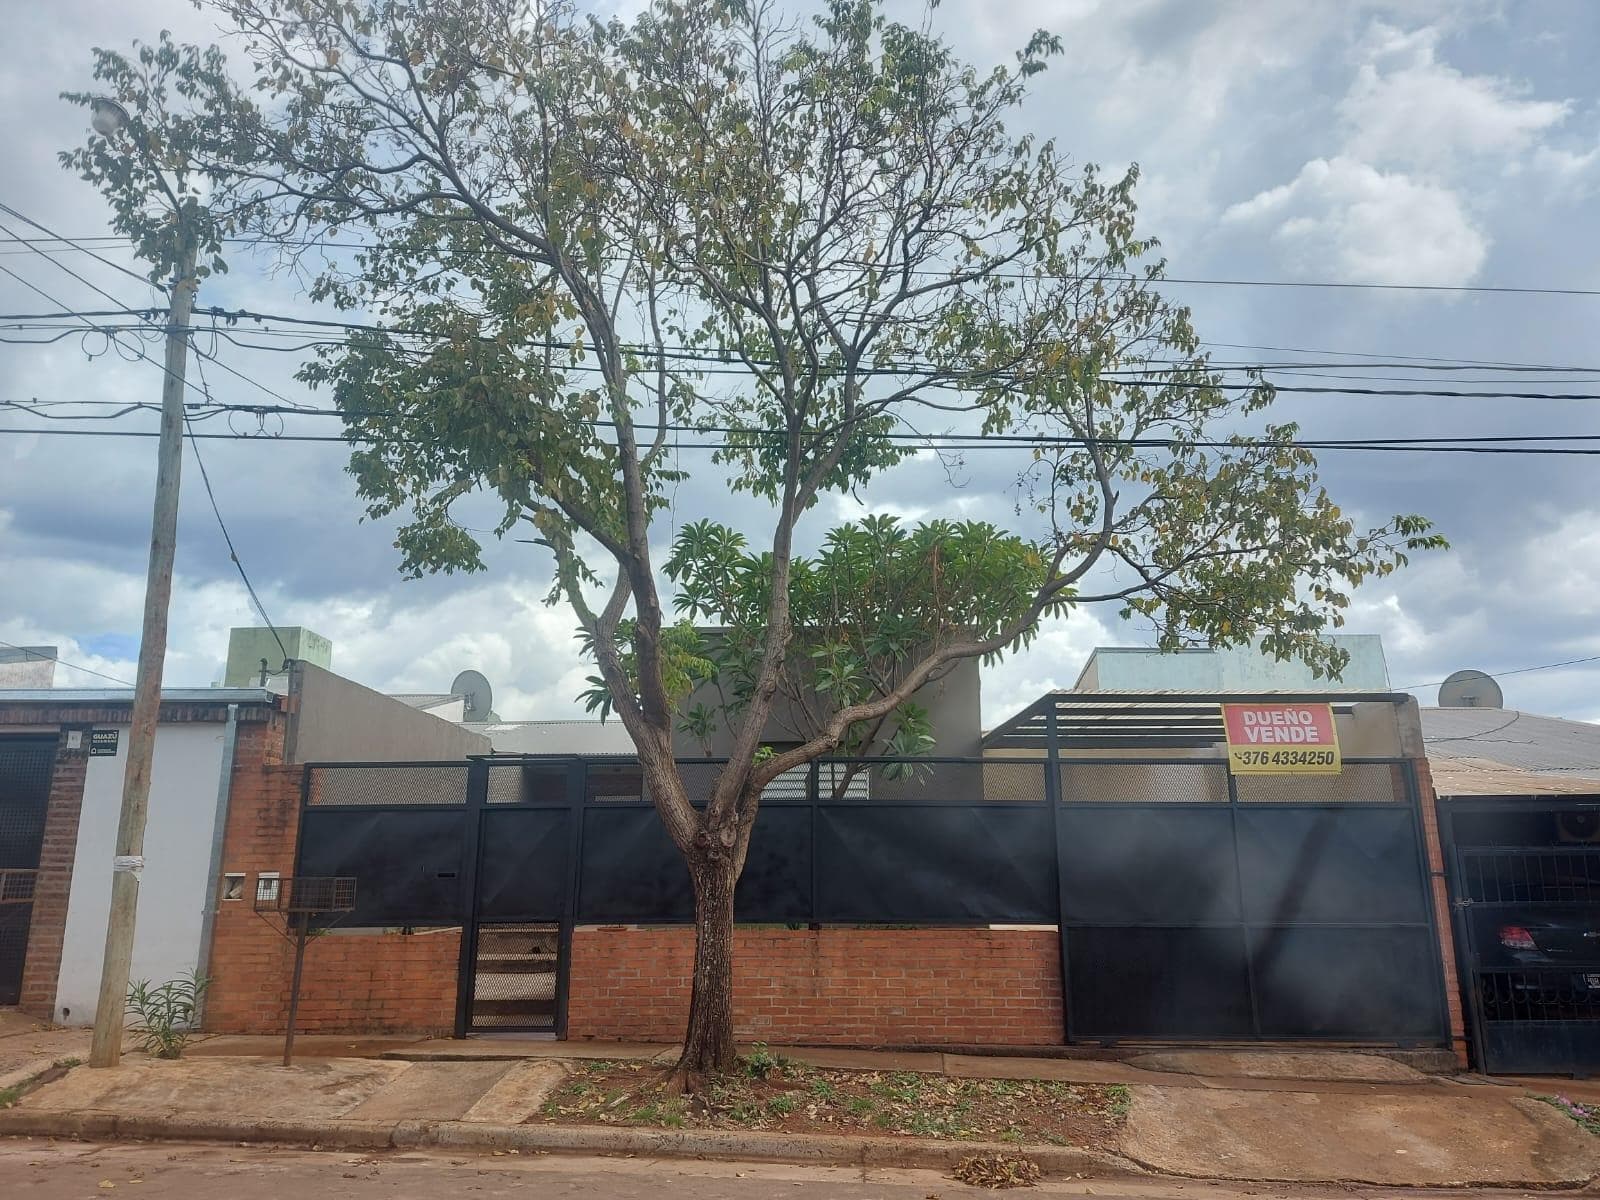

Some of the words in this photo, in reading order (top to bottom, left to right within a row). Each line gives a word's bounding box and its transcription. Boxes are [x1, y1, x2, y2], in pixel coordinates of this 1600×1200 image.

[1243, 708, 1313, 726] DUEÑO
[1243, 727, 1320, 743] VENDE
[1243, 751, 1269, 765] 376
[1272, 751, 1335, 765] 4334250
